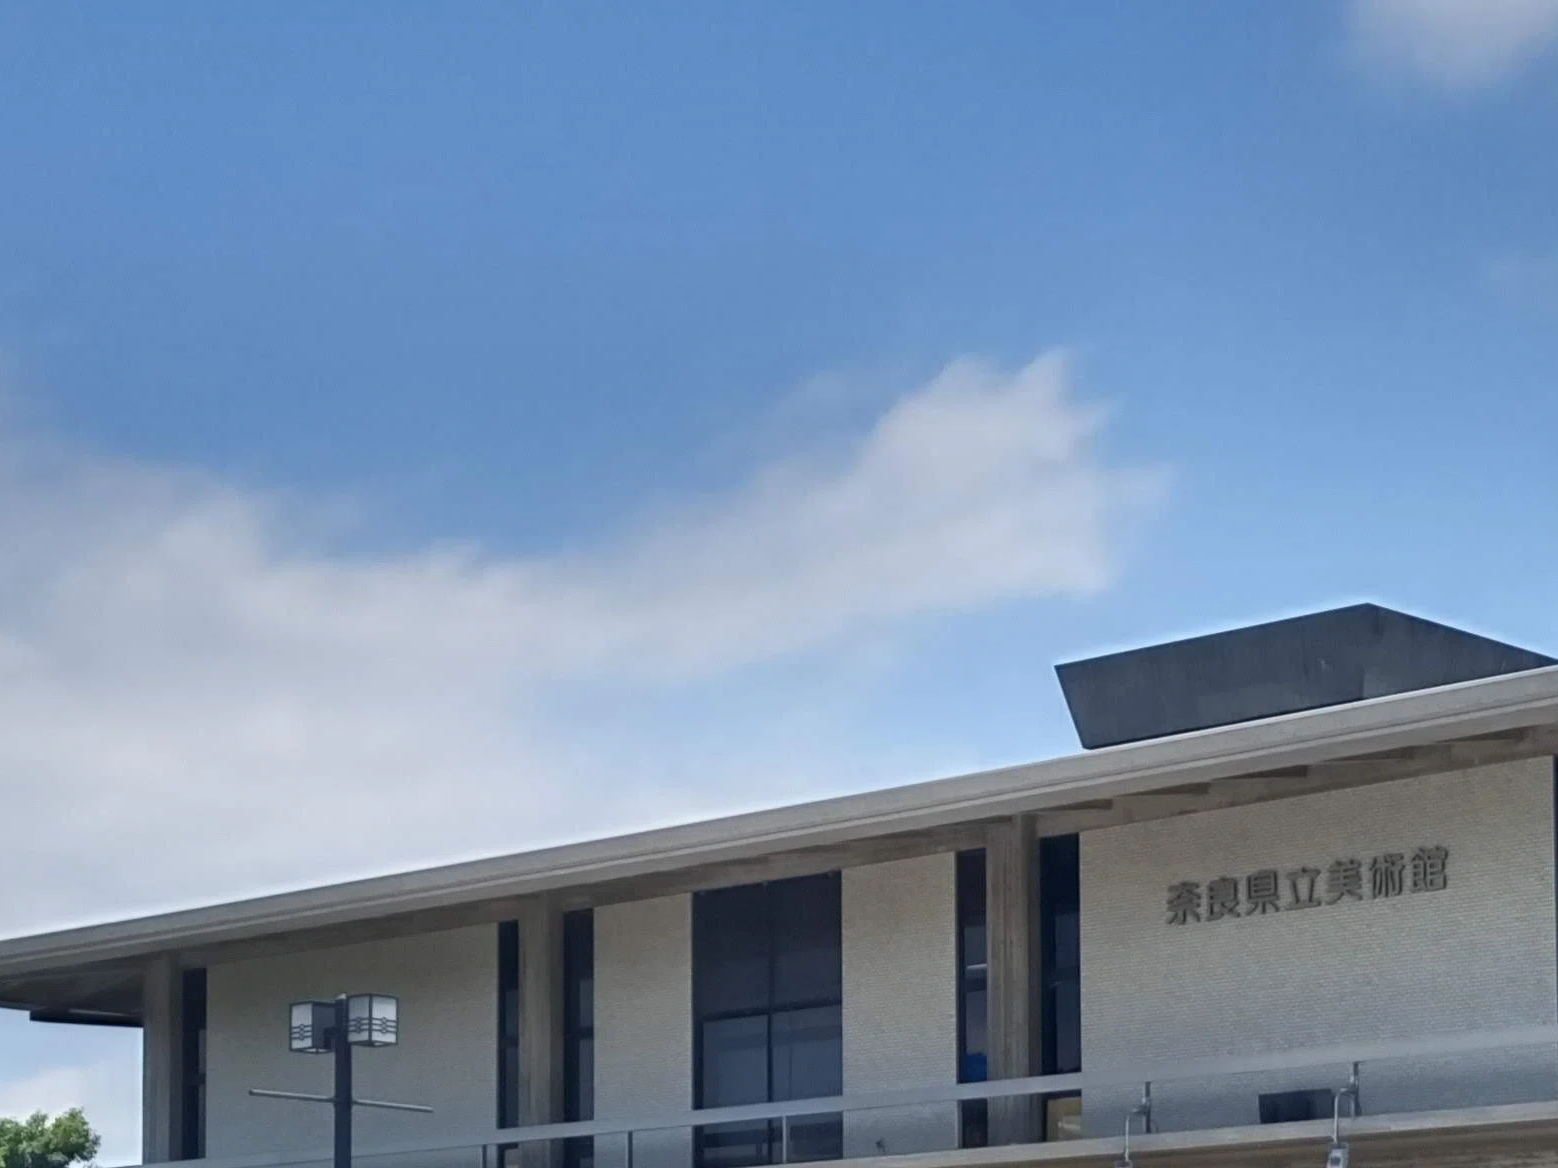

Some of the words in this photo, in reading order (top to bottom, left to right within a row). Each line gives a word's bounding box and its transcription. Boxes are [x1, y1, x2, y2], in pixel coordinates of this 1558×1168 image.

[1166, 845, 1450, 925] 奈良県立美術館
